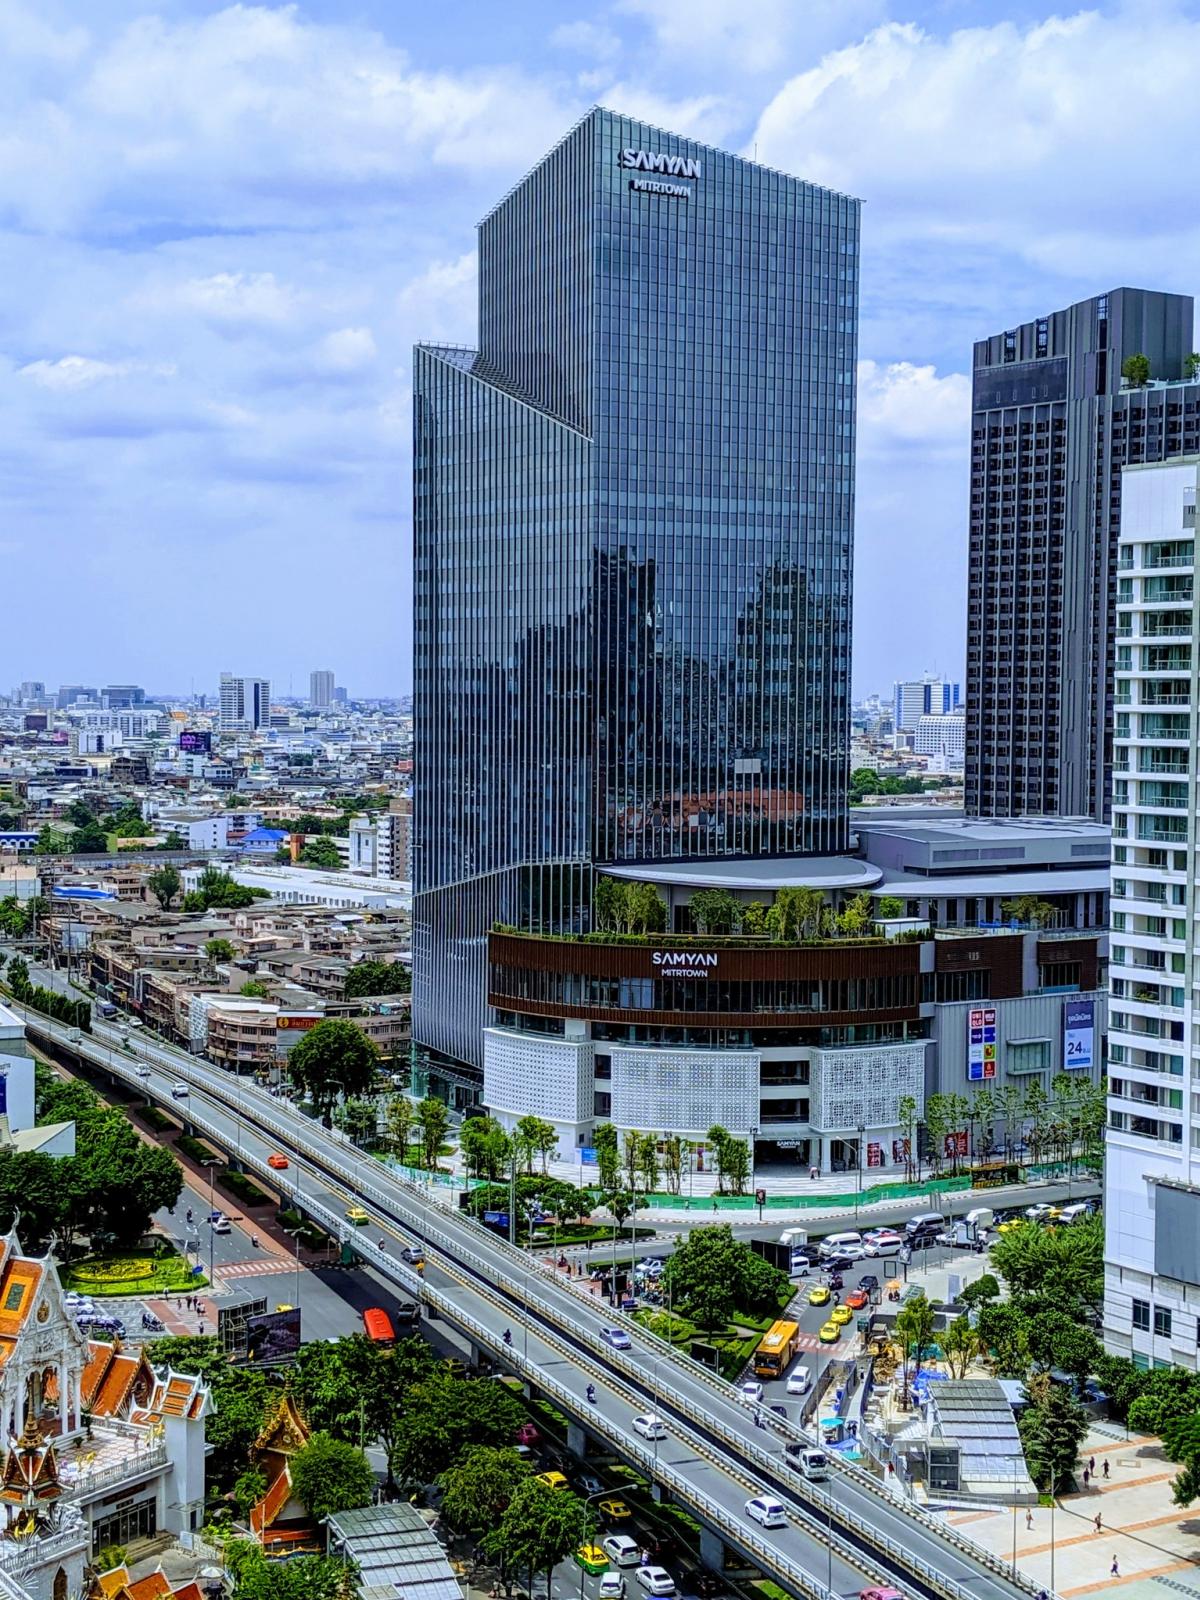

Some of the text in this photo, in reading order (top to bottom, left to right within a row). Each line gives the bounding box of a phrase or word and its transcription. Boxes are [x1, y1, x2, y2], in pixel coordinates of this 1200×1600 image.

[623, 148, 701, 178] SAMYAN
[633, 179, 691, 197] MITRTOWN
[652, 952, 718, 966] SAMYAN
[661, 969, 708, 977] MITRTOWN
[1068, 1041, 1082, 1055] 24
